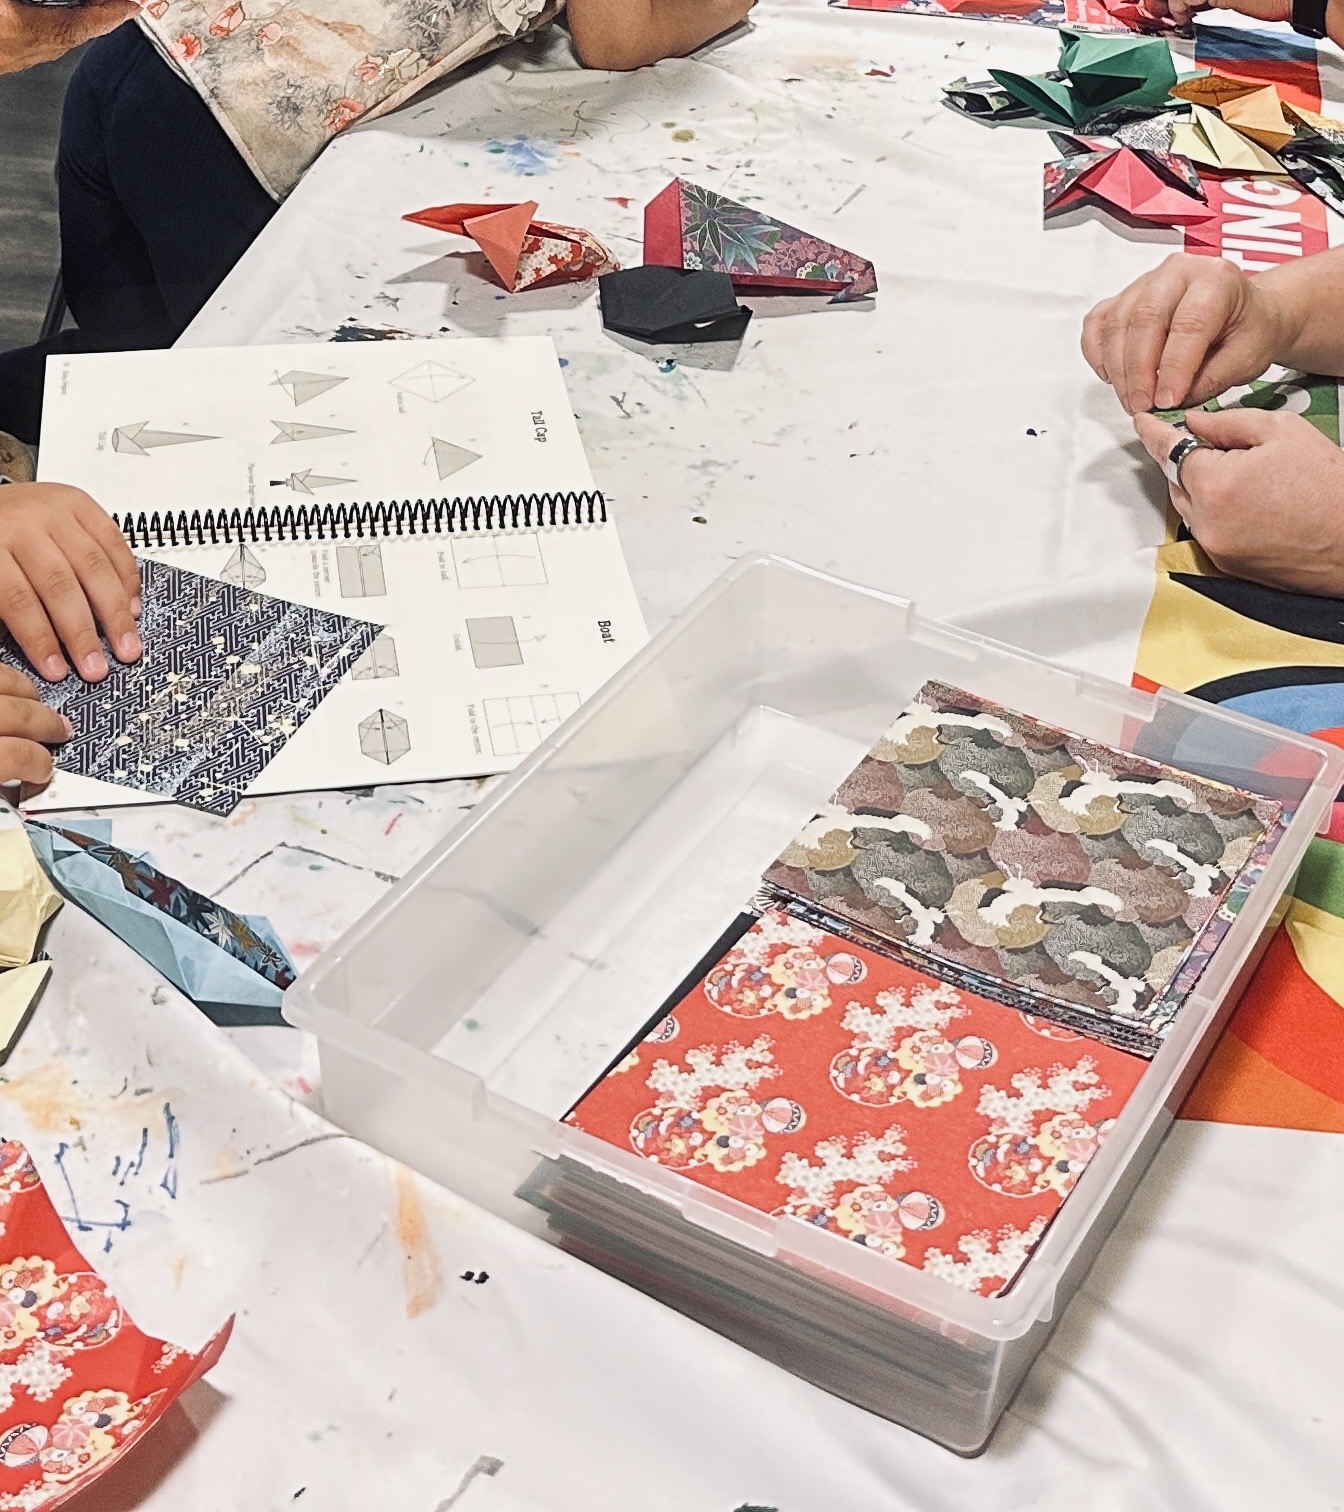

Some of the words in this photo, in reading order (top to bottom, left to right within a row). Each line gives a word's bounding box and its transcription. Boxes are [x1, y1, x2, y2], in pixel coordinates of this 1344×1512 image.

[531, 410, 546, 425] Tall
[534, 427, 547, 443] Cap
[597, 620, 616, 644] Boat
